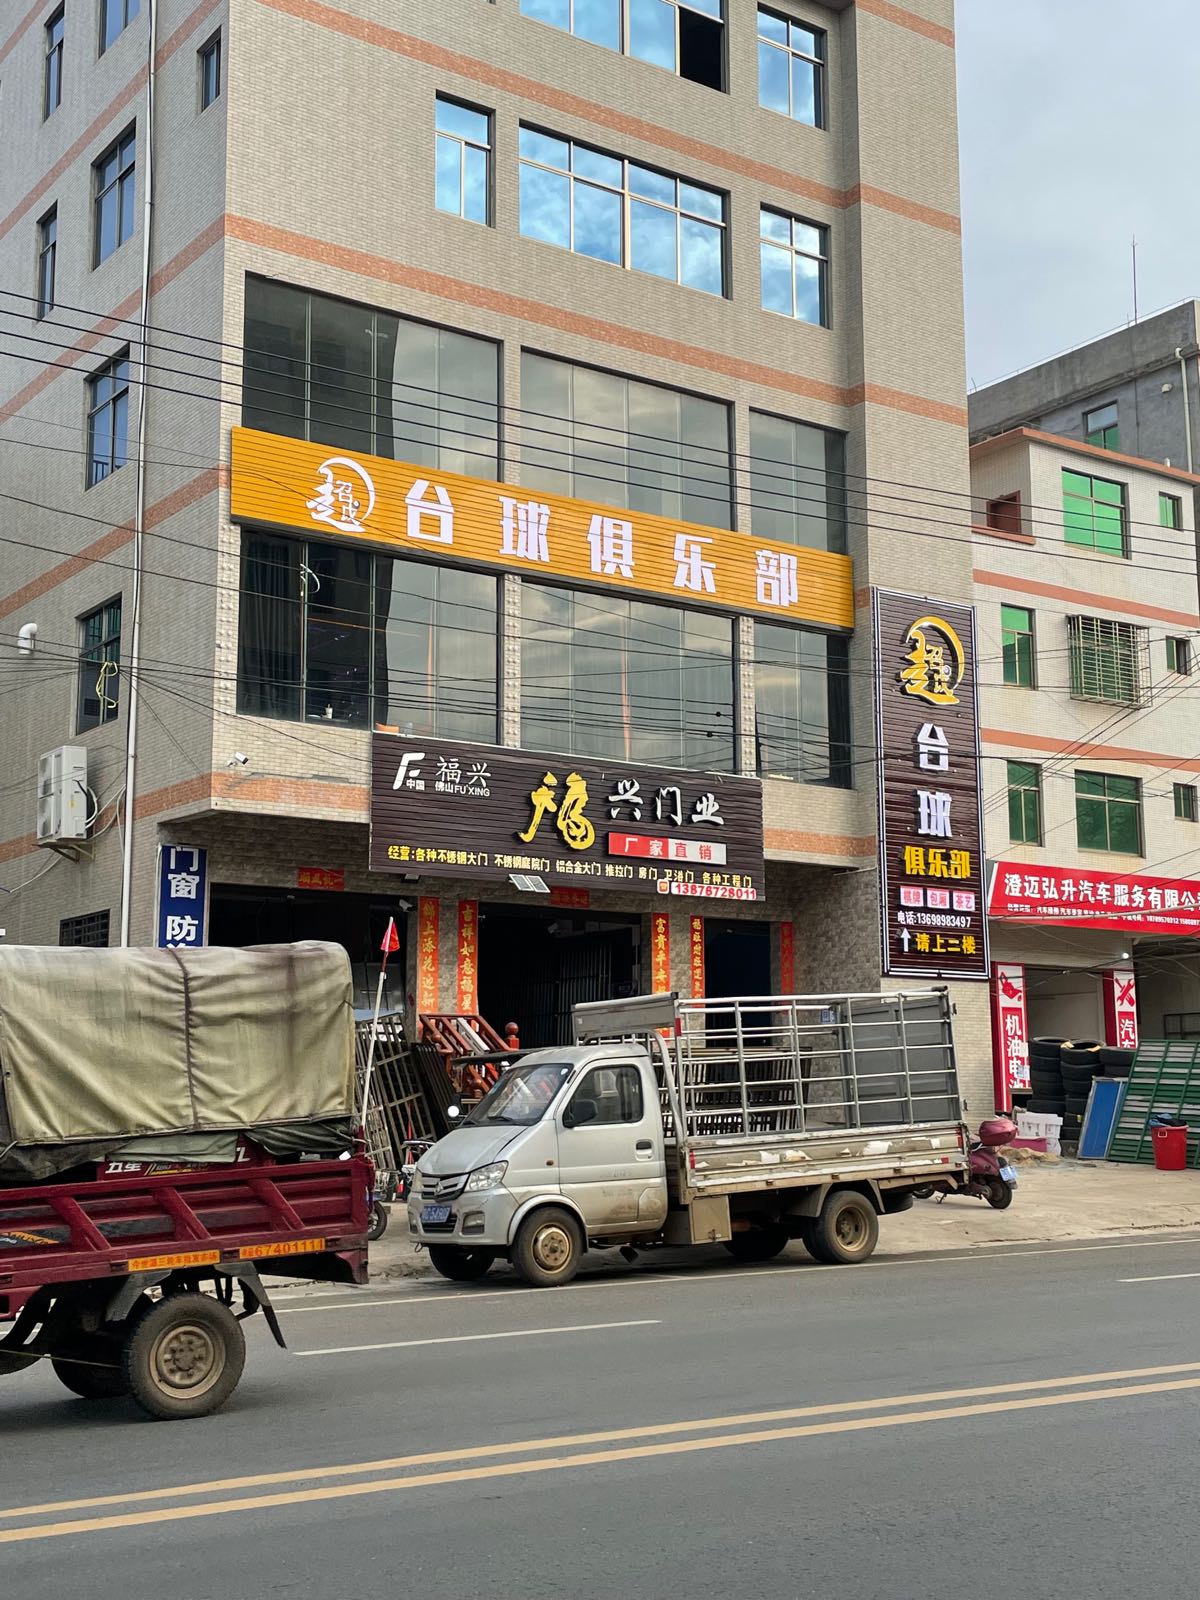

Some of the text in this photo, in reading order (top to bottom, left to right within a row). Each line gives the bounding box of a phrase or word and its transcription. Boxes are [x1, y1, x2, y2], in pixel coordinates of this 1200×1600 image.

[404, 478, 799, 608] 台球俱乐部
[406, 779, 425, 791] 中国
[435, 756, 492, 788] 福兴
[916, 722, 953, 838] 台球
[623, 836, 713, 862] 厂家直销
[903, 845, 971, 879] 俱乐部
[494, 854, 551, 872] 不锈钢庭院门
[555, 859, 602, 876] 铝合金大门
[605, 864, 634, 879] 推拉门
[638, 866, 658, 881] 房门
[663, 869, 695, 883] 卫浴门
[702, 872, 753, 888] 各种工程门
[165, 846, 200, 948] 门窗 防
[674, 883, 757, 900] 13876728011
[903, 890, 921, 904] 棋牌
[955, 894, 973, 909] 茶艺
[1004, 872, 1200, 912] 澄迈弘升汽车服务有限公
[460, 904, 475, 1014] 吉祥如意福星
[915, 932, 977, 955] 请上二楼
